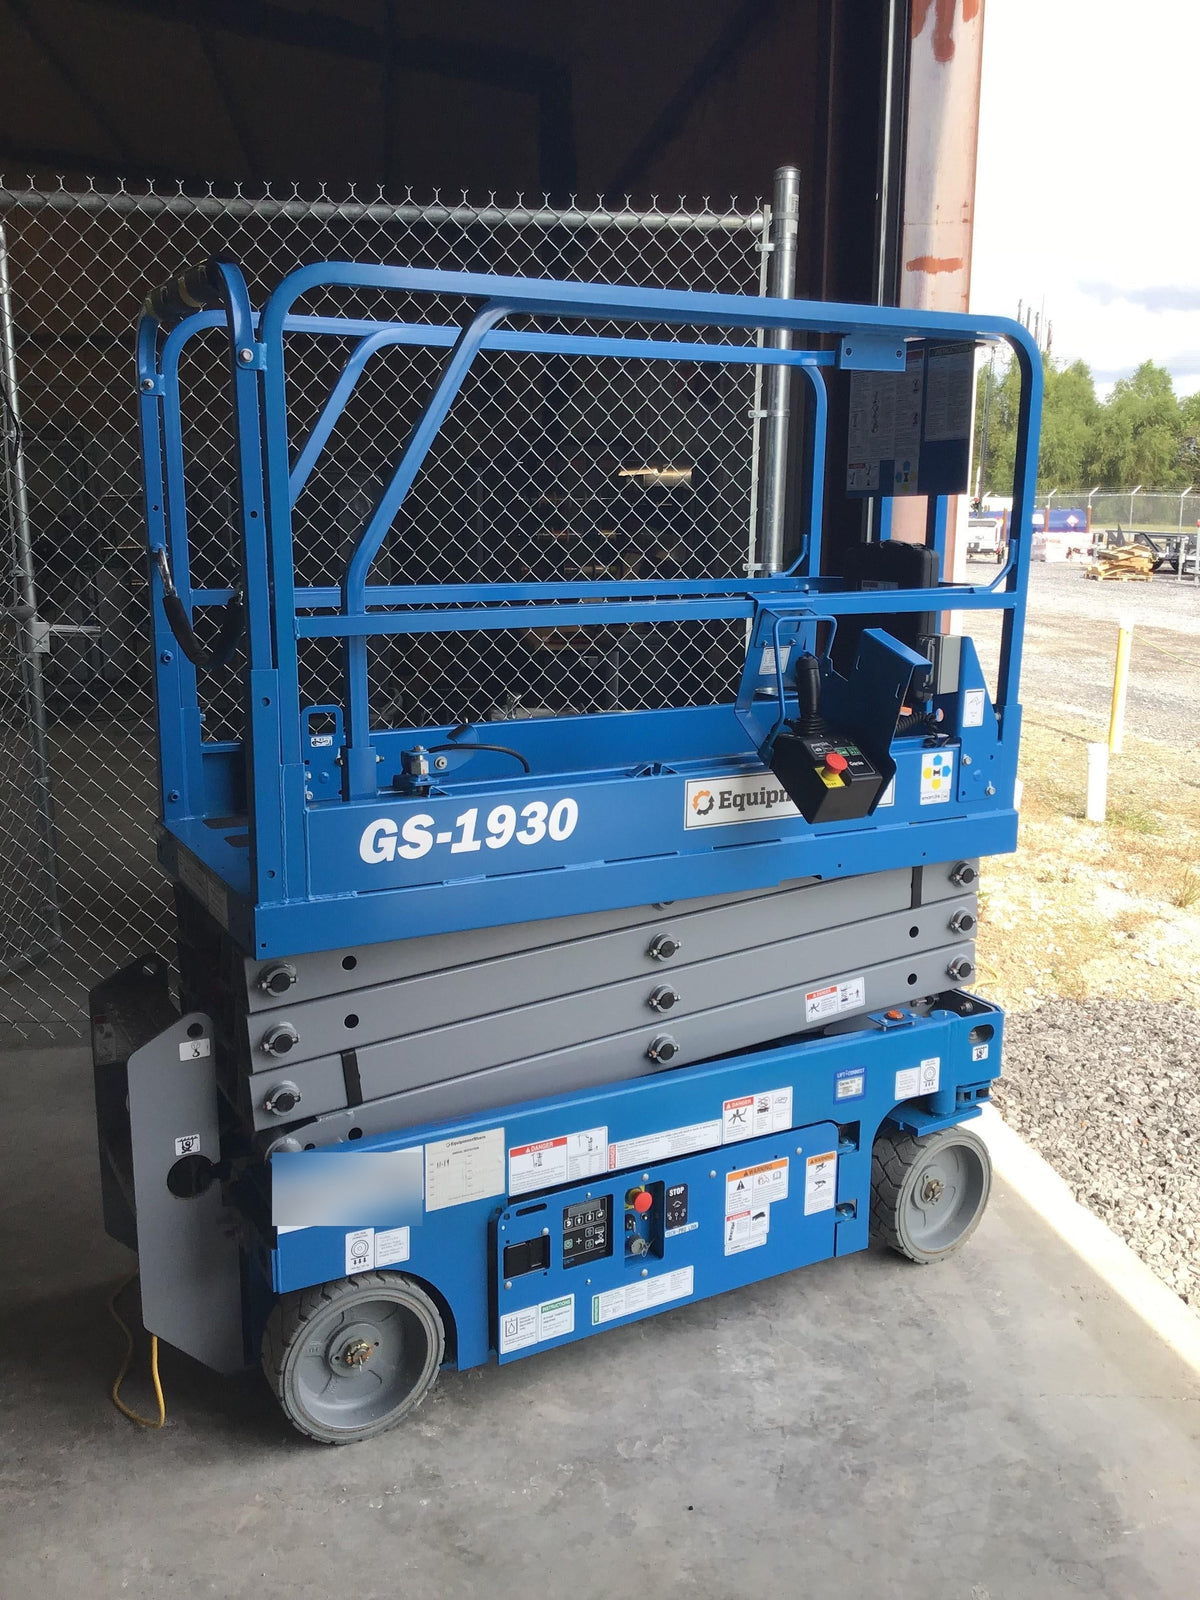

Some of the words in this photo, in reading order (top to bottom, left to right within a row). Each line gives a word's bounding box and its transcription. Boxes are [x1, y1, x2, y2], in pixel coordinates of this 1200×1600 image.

[359, 797, 579, 864] GS-1930
[731, 1098, 752, 1108] DANGER
[531, 1141, 554, 1152] DANGER
[749, 1164, 773, 1175] WARNING
[669, 1186, 685, 1197] STOP
